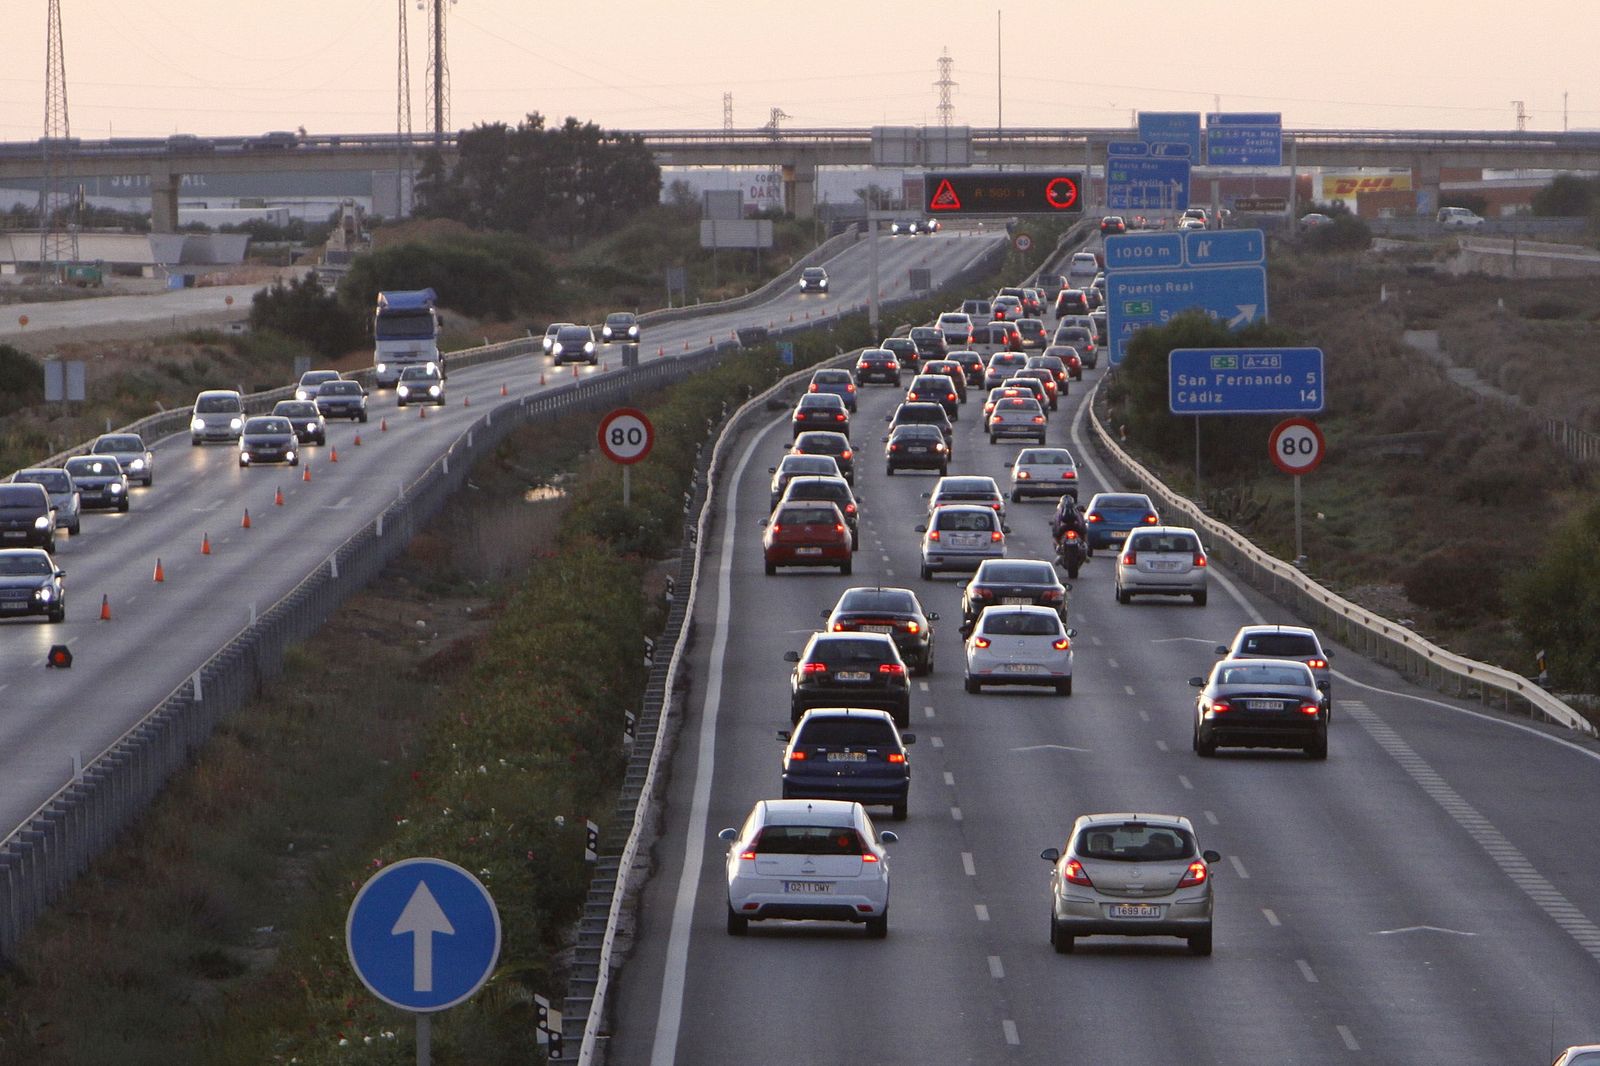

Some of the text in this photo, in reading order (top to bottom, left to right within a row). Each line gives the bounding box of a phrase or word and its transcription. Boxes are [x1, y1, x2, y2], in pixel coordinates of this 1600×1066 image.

[1116, 246, 1170, 258] 1000 m
[1118, 281, 1194, 295] Puerto Real
[1125, 302, 1151, 314] E-5
[1213, 356, 1279, 368] E-5 A-48
[1177, 372, 1317, 387] San Fernando 5
[1177, 389, 1317, 403] Cádiz 14
[611, 427, 642, 446] 80
[1282, 437, 1313, 456] 80
[790, 883, 812, 893] 0211
[1117, 907, 1139, 916] 1699
